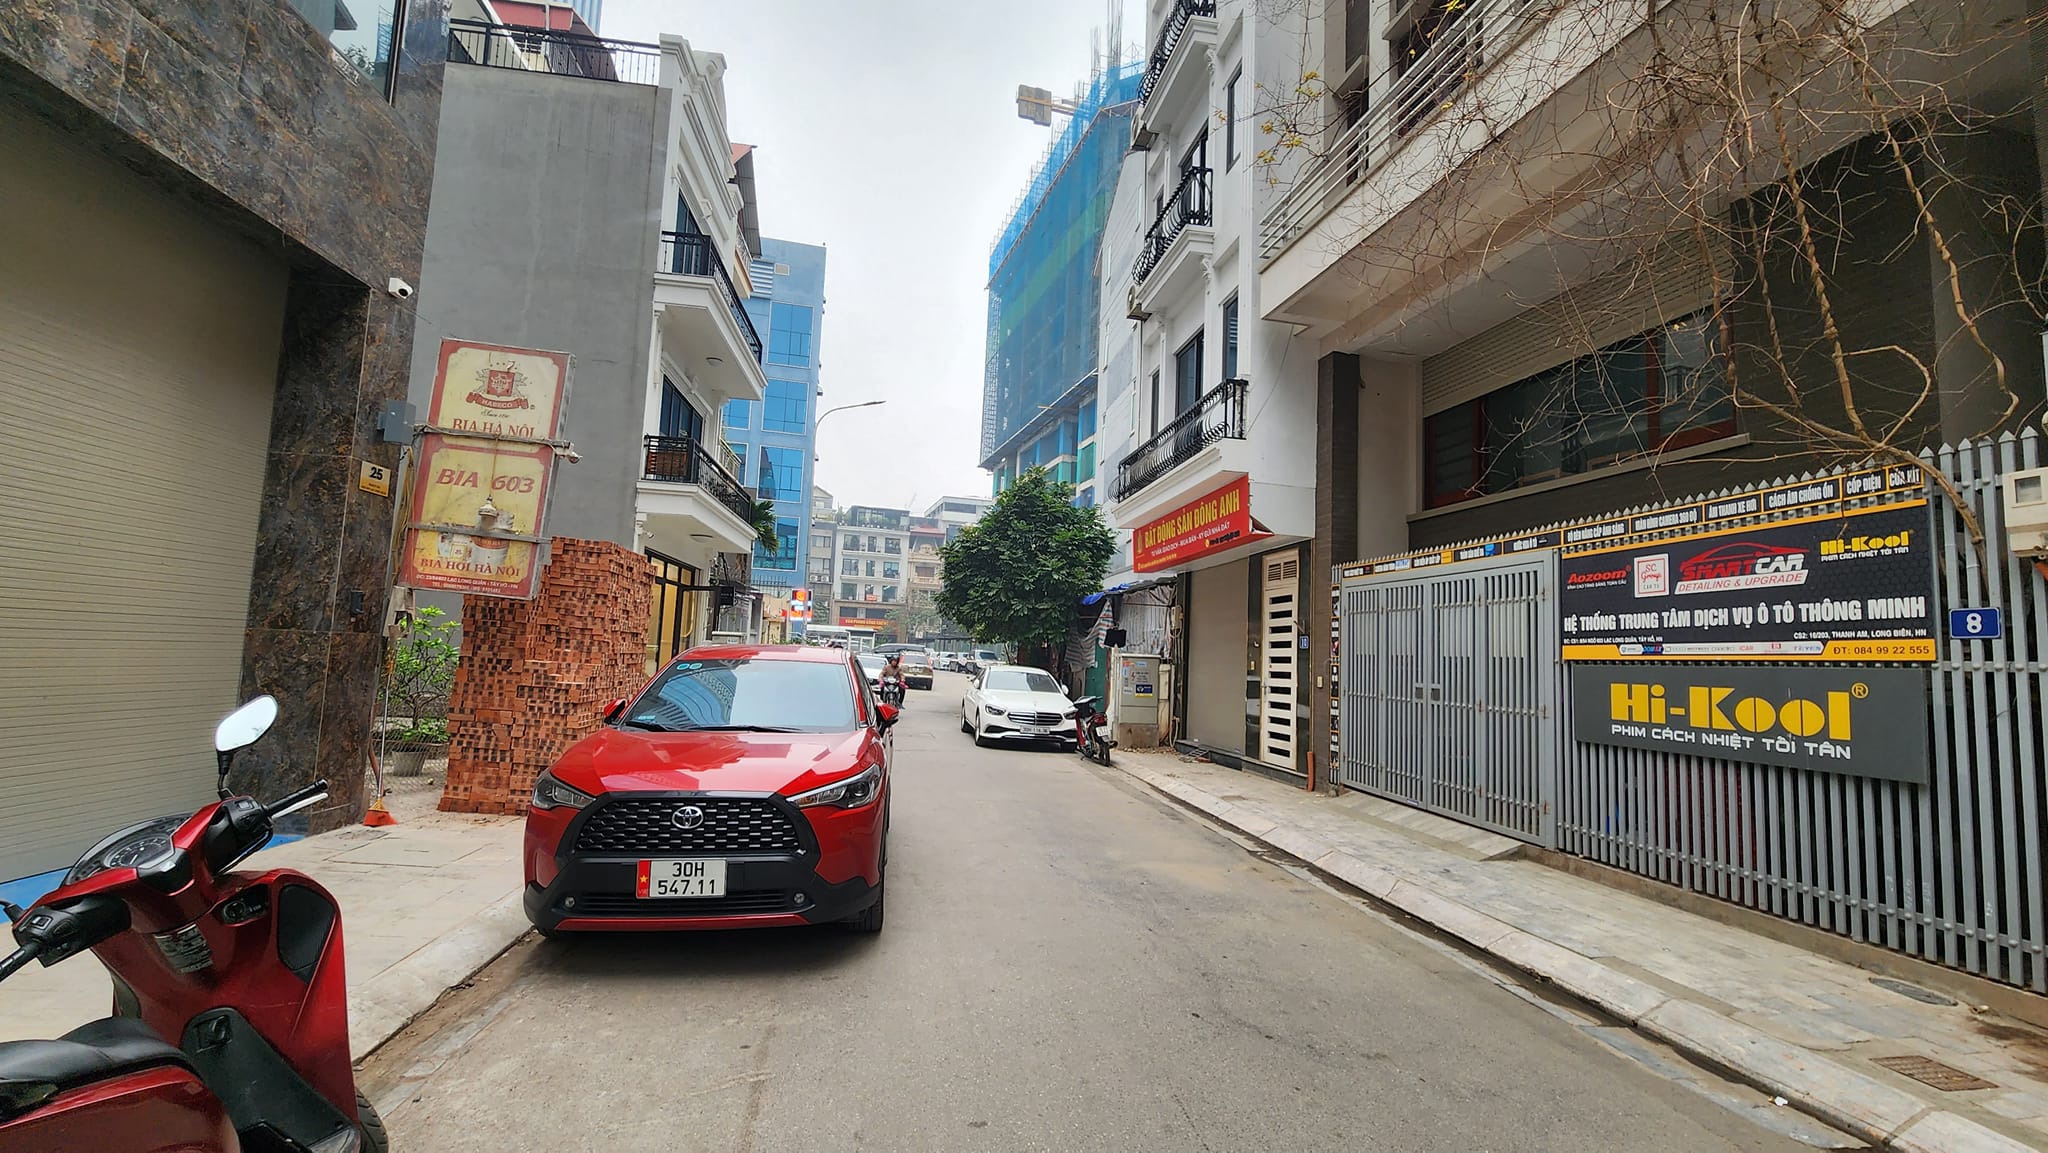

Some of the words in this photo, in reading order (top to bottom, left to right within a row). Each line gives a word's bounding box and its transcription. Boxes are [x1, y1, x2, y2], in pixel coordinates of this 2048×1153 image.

[369, 466, 383, 480] 25
[436, 468, 478, 488] BIA
[491, 475, 535, 493] 603
[1846, 479, 1862, 494] CỐP
[1862, 474, 1882, 494] ĐIỆN
[1768, 492, 1786, 508] CÁCH
[1787, 488, 1798, 504] ÂM
[1799, 484, 1822, 502] CHỐNG
[1737, 500, 1746, 514] XE
[1144, 524, 1160, 549] BẤT
[1157, 520, 1176, 546] ĐỘNG
[1176, 508, 1194, 537] SẢN
[1194, 500, 1218, 530] ĐÔNG
[1219, 488, 1240, 518] ANH
[1659, 512, 1679, 528] CAMERA
[1820, 530, 1909, 556] Hi-Kool
[420, 558, 442, 569] BIA
[474, 562, 492, 574] HÀ
[496, 564, 520, 577] NỘI
[1568, 570, 1628, 584] Aozoom
[1641, 572, 1662, 582] Group
[1646, 563, 1656, 572] SC
[1679, 578, 1730, 592] DETAILING
[1734, 578, 1741, 586] &
[1744, 572, 1804, 586] UPGRADE
[1564, 614, 1578, 634] HỆ
[1580, 610, 1616, 632] THỐNG
[1619, 612, 1659, 630] TRUNG
[1662, 608, 1690, 628] TÂM
[1694, 608, 1728, 630] DỊCH
[1732, 606, 1753, 628] VỤ
[1758, 602, 1769, 624] Ô
[1772, 600, 1794, 624] TÔ
[1798, 598, 1862, 622] THÔNG
[1868, 596, 1926, 620] MINH
[1966, 612, 1982, 634] 8
[1893, 628, 1913, 637] BIÊN,
[1833, 646, 1850, 654] ĐT:
[1854, 646, 1872, 654] 084
[1909, 646, 1930, 654] 555
[1610, 683, 1852, 741] Hi-Kool
[1612, 724, 1646, 738] PHIM
[1651, 726, 1696, 743] CÁCH
[1702, 733, 1754, 751] NHIỆT
[1804, 742, 1851, 760] TÂN
[672, 862, 705, 878] 30H
[658, 880, 715, 895] 547.11
